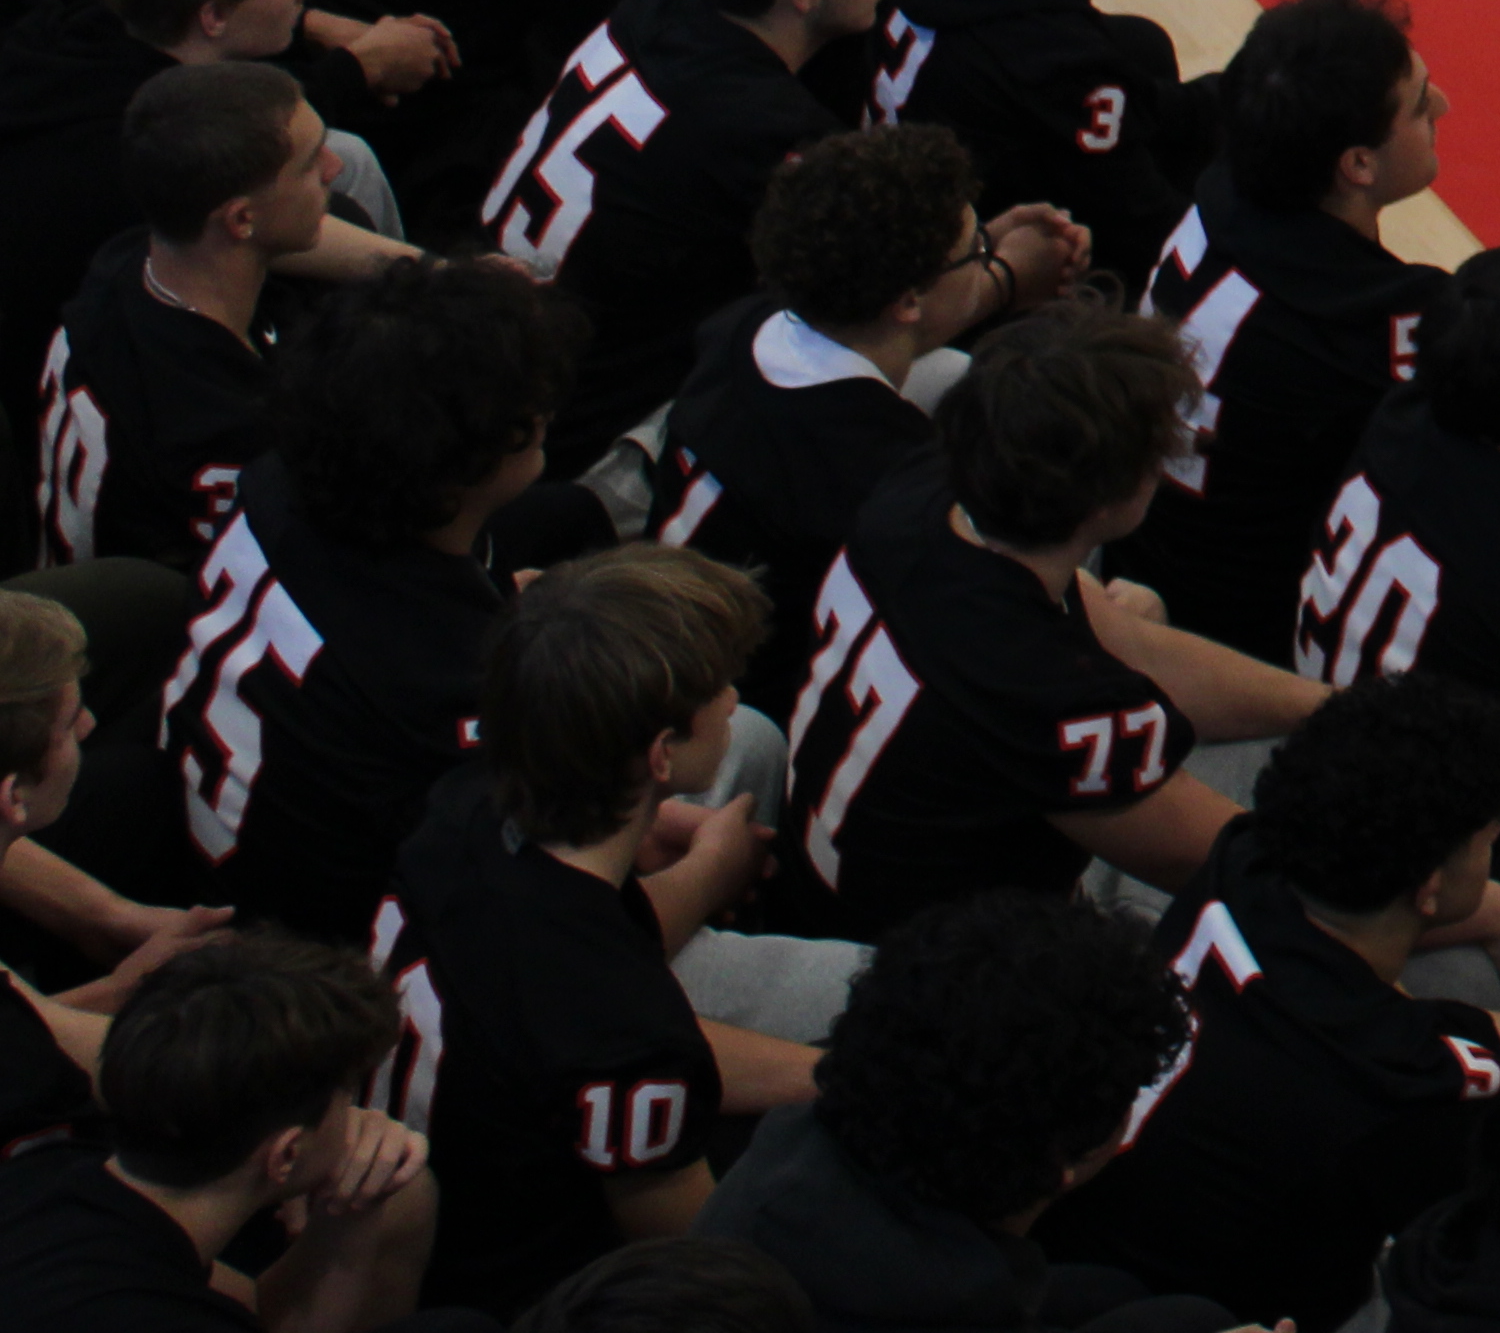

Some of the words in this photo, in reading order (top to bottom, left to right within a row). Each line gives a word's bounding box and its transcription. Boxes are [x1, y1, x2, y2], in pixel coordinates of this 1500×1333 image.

[1076, 83, 1127, 155] 3
[1293, 471, 1443, 690] 20
[157, 506, 327, 868] 75
[787, 543, 925, 895] 77
[1057, 700, 1169, 796] 77
[575, 1079, 688, 1173] 10
